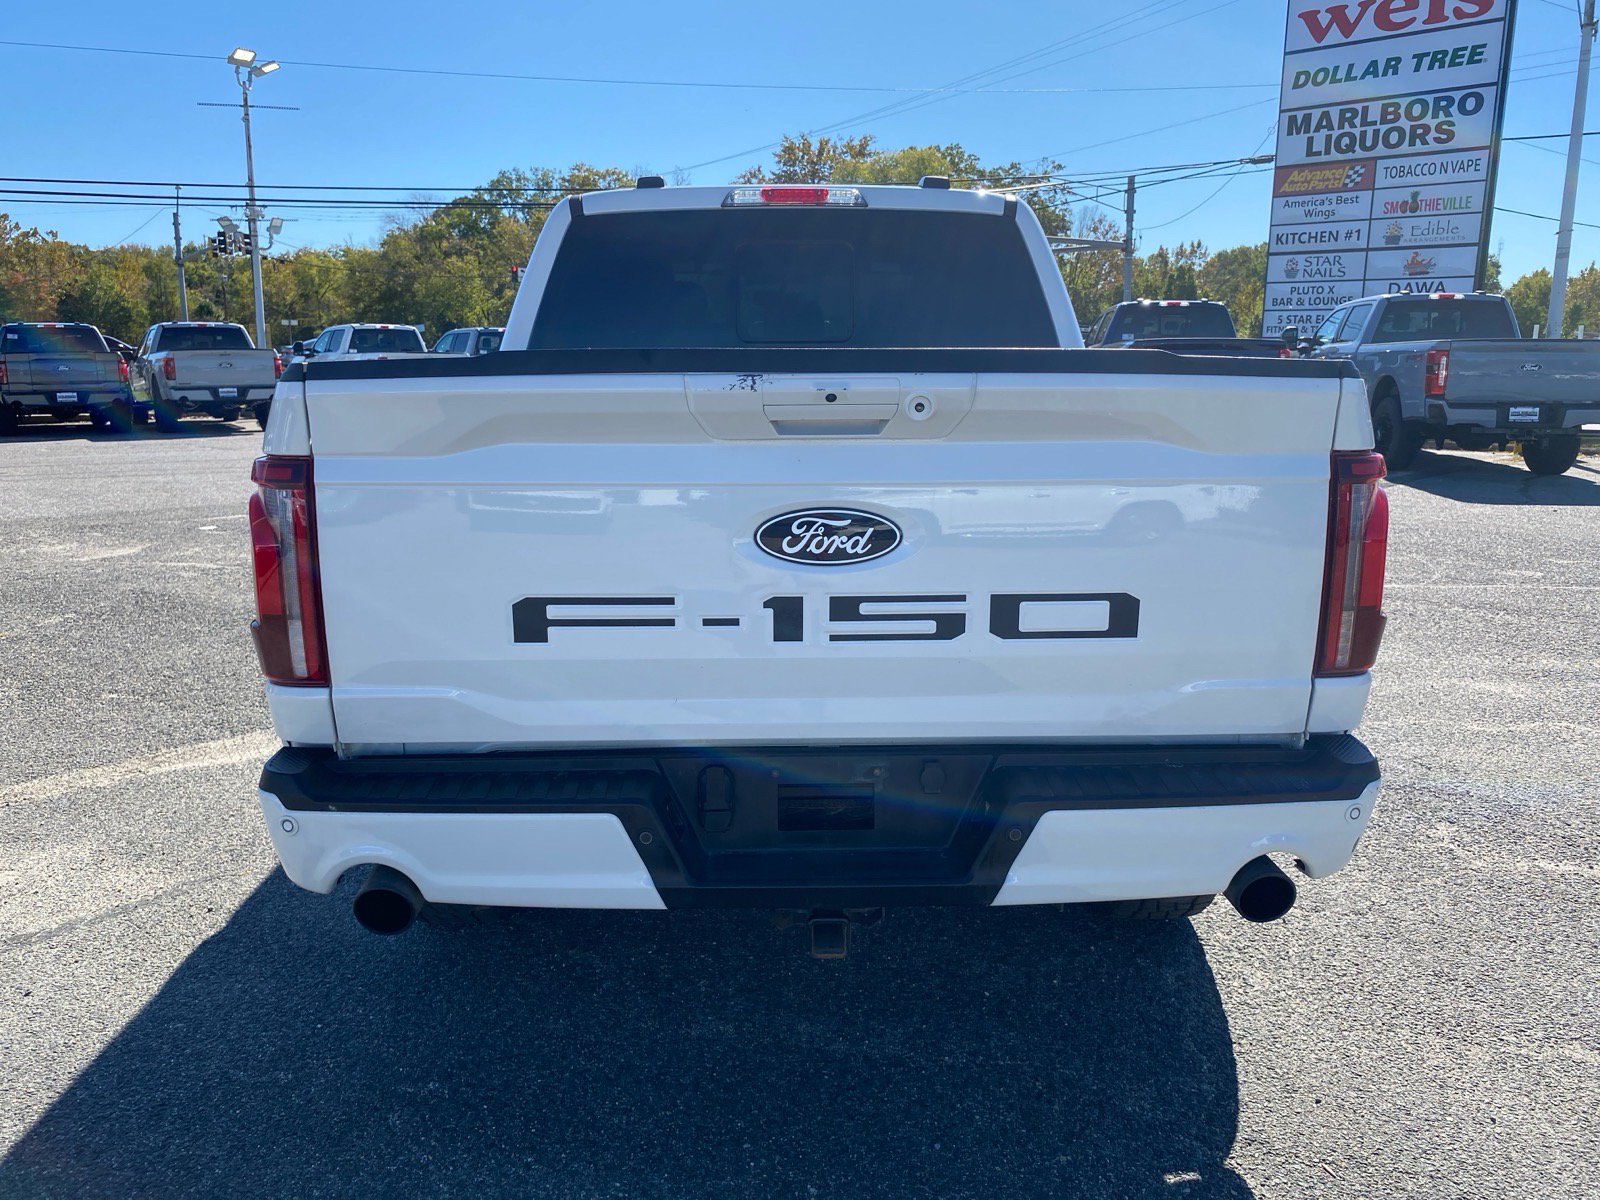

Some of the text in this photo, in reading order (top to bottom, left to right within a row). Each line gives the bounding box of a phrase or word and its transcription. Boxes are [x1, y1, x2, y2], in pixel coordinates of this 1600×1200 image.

[1291, 43, 1488, 90] DOLLAR TREE
[1286, 91, 1485, 136] MARLBORO
[1305, 120, 1456, 158] LIQUORS
[1286, 168, 1344, 181] Advance
[1383, 158, 1481, 179] TOBACCO N VAPE
[1280, 179, 1340, 192] Auto Parts
[1283, 195, 1360, 209] America's Best
[1304, 208, 1336, 220] Wings
[1411, 220, 1459, 237] Edible
[1275, 228, 1361, 245] KITCHEN #1
[1403, 235, 1466, 243] ARRANGEMENTS
[1304, 255, 1343, 268] STAR
[1302, 266, 1346, 278] NAILS
[1290, 285, 1335, 295] PLUTO X
[1388, 281, 1446, 293] DAWA
[1271, 297, 1293, 307] BAR
[1295, 297, 1305, 306] &
[1277, 314, 1283, 324] 5
[1286, 314, 1312, 324] STAR
[782, 517, 875, 554] Ford
[512, 592, 1140, 643] F-150
